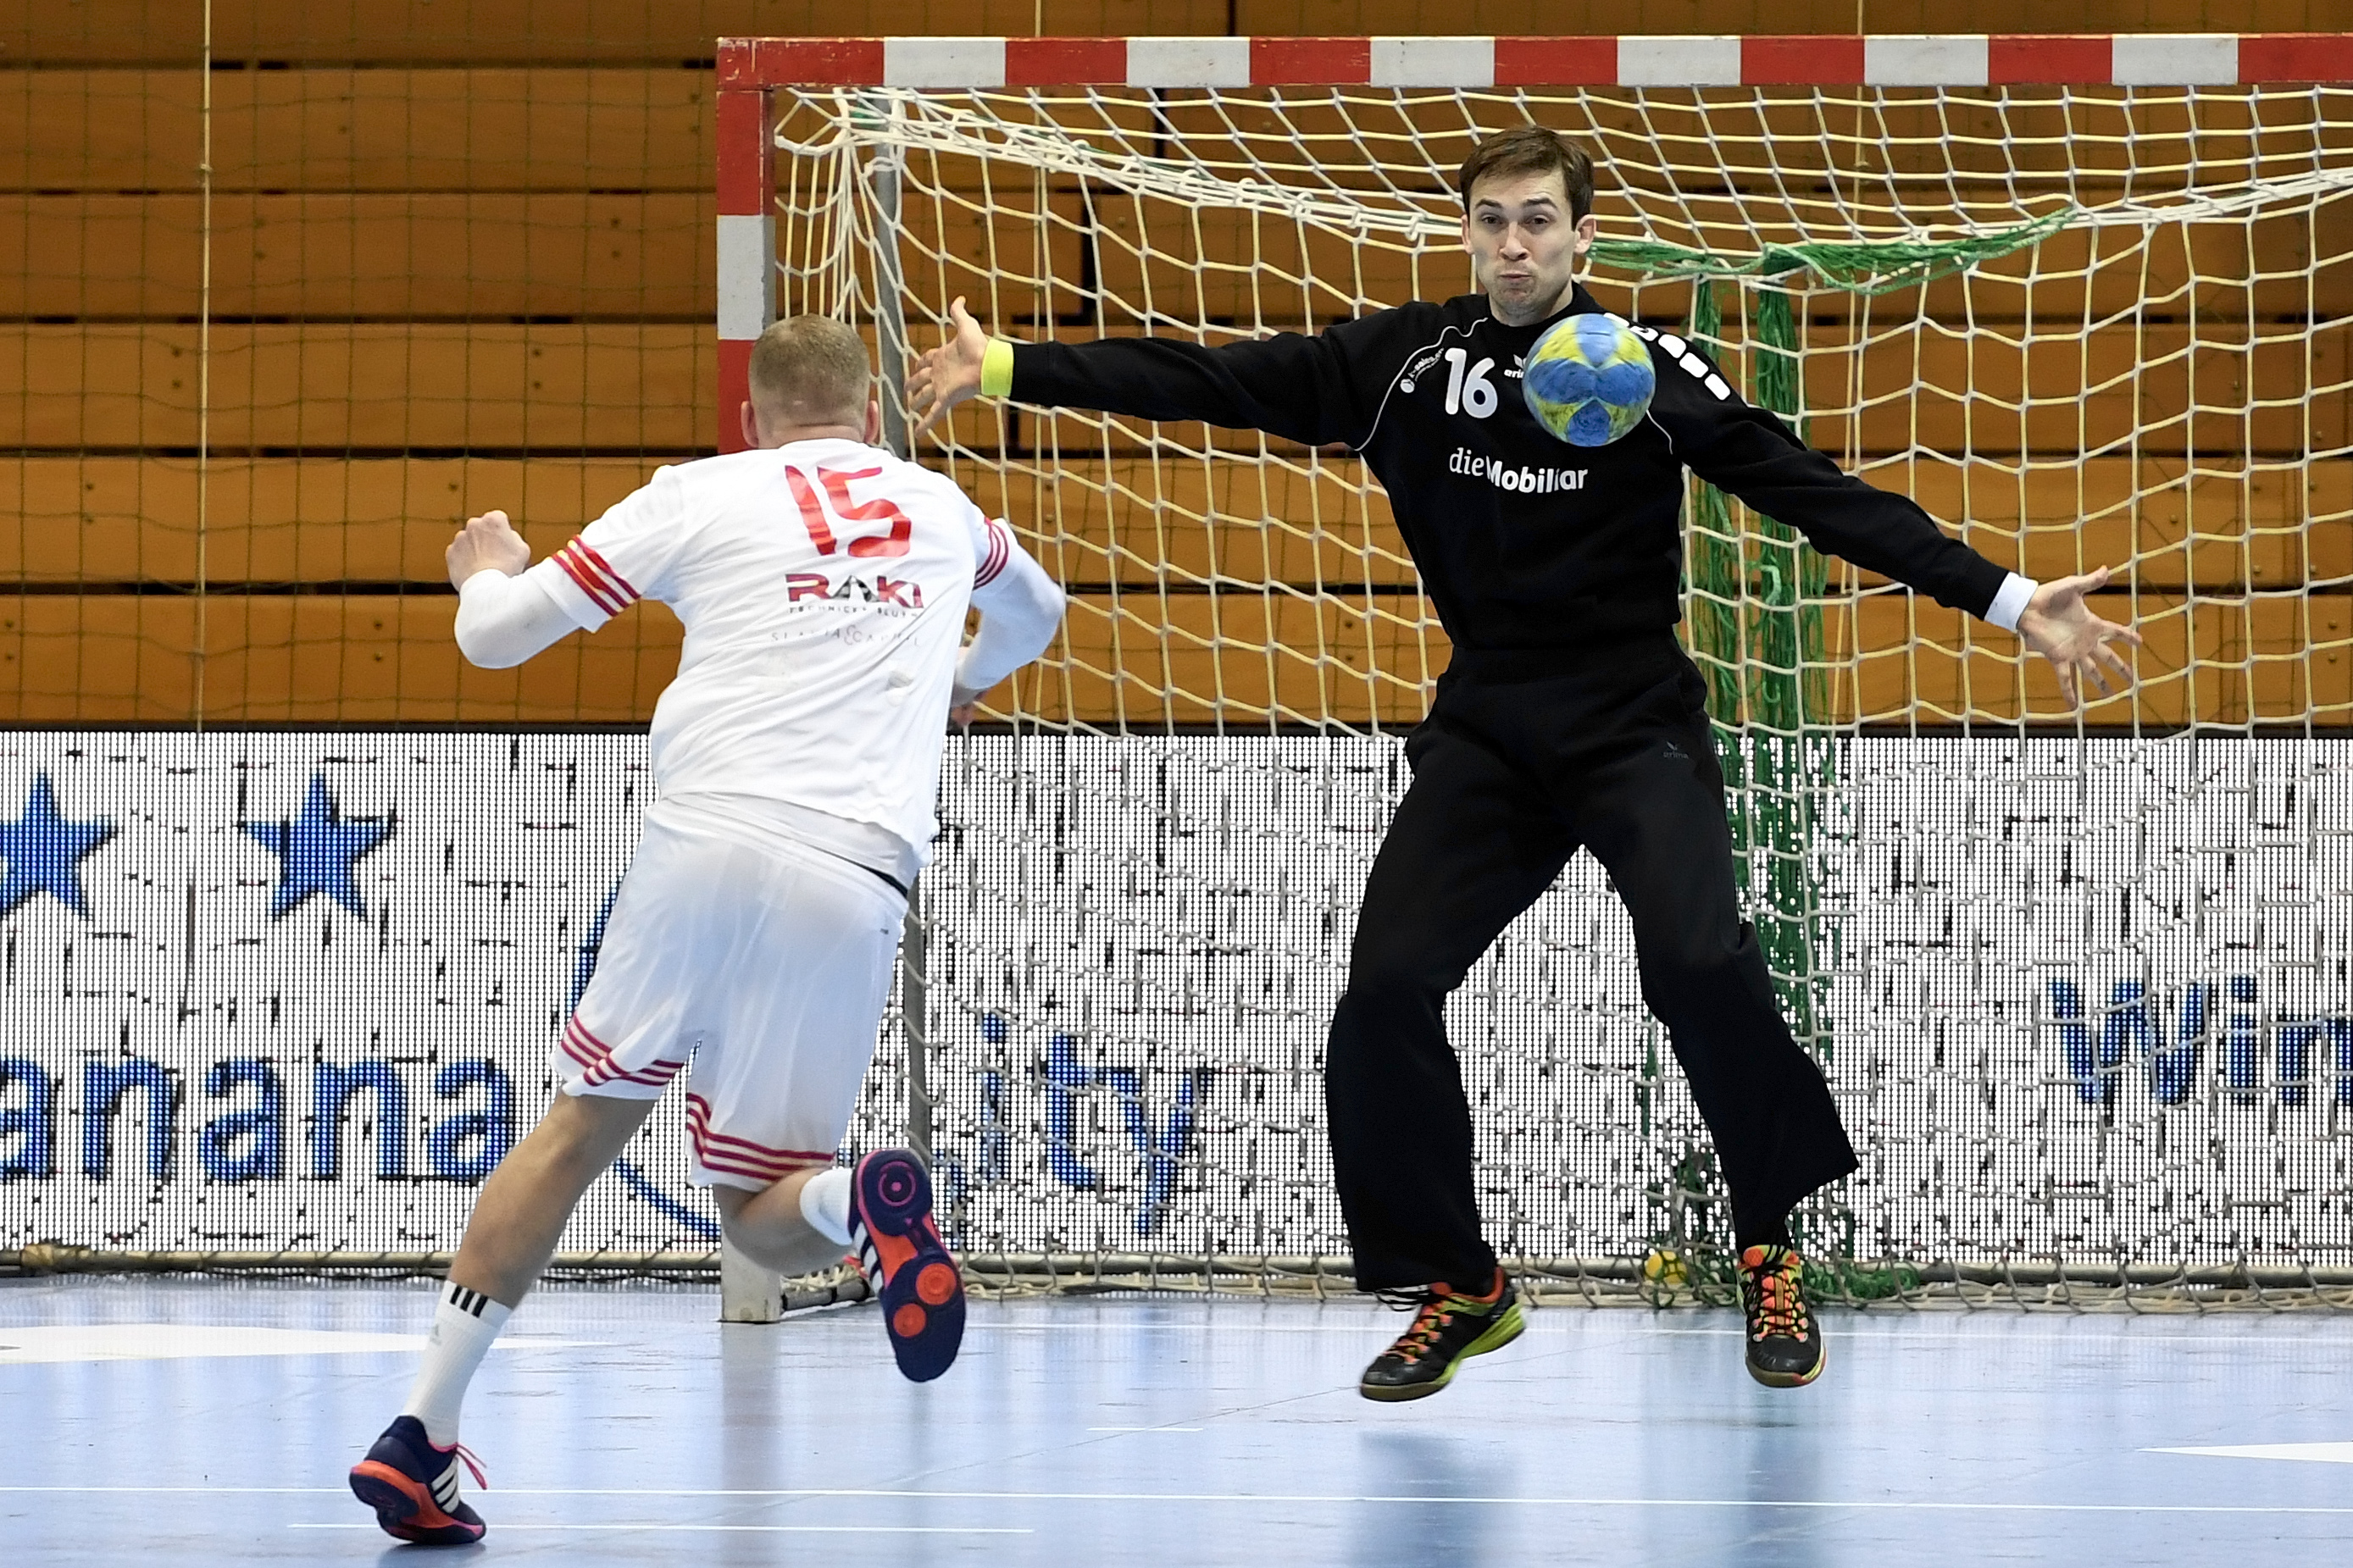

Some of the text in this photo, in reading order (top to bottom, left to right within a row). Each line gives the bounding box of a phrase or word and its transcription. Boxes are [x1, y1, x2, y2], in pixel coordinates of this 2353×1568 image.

[1445, 348, 1498, 418] 16
[1504, 368, 1524, 379] eri
[1449, 447, 1589, 493] dieMobiliar
[785, 465, 912, 557] 15
[0, 1056, 513, 1181] anana
